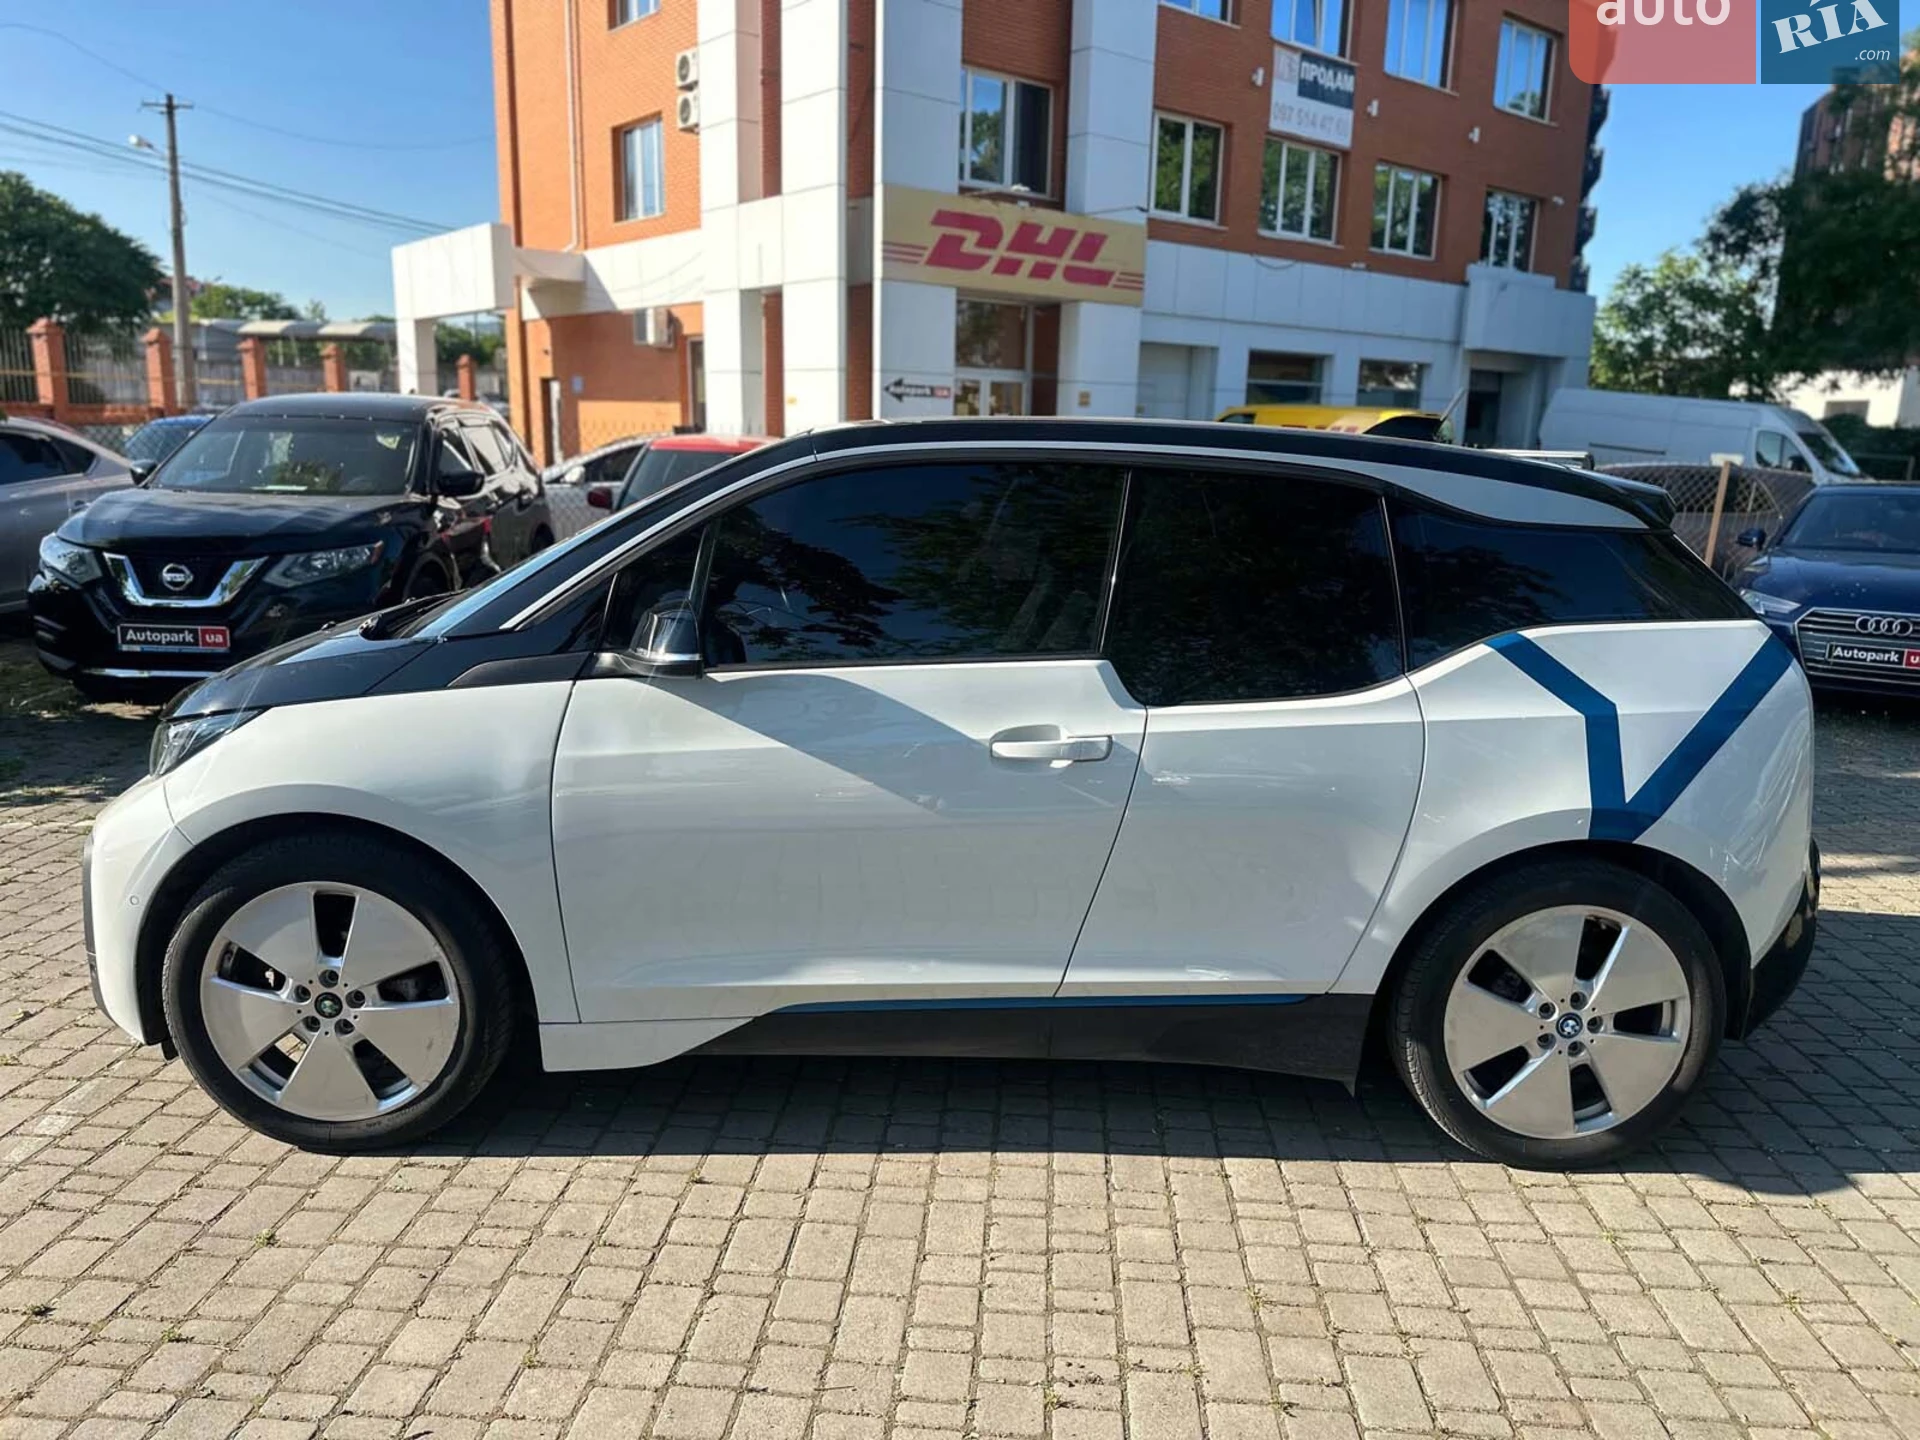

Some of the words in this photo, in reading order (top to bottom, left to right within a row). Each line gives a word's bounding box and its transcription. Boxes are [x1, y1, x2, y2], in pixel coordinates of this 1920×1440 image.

[924, 209, 1115, 286] DHL
[126, 628, 194, 644] Autopark
[205, 634, 223, 643] ua
[1833, 646, 1899, 662] Autopark
[1910, 655, 1920, 664] u
